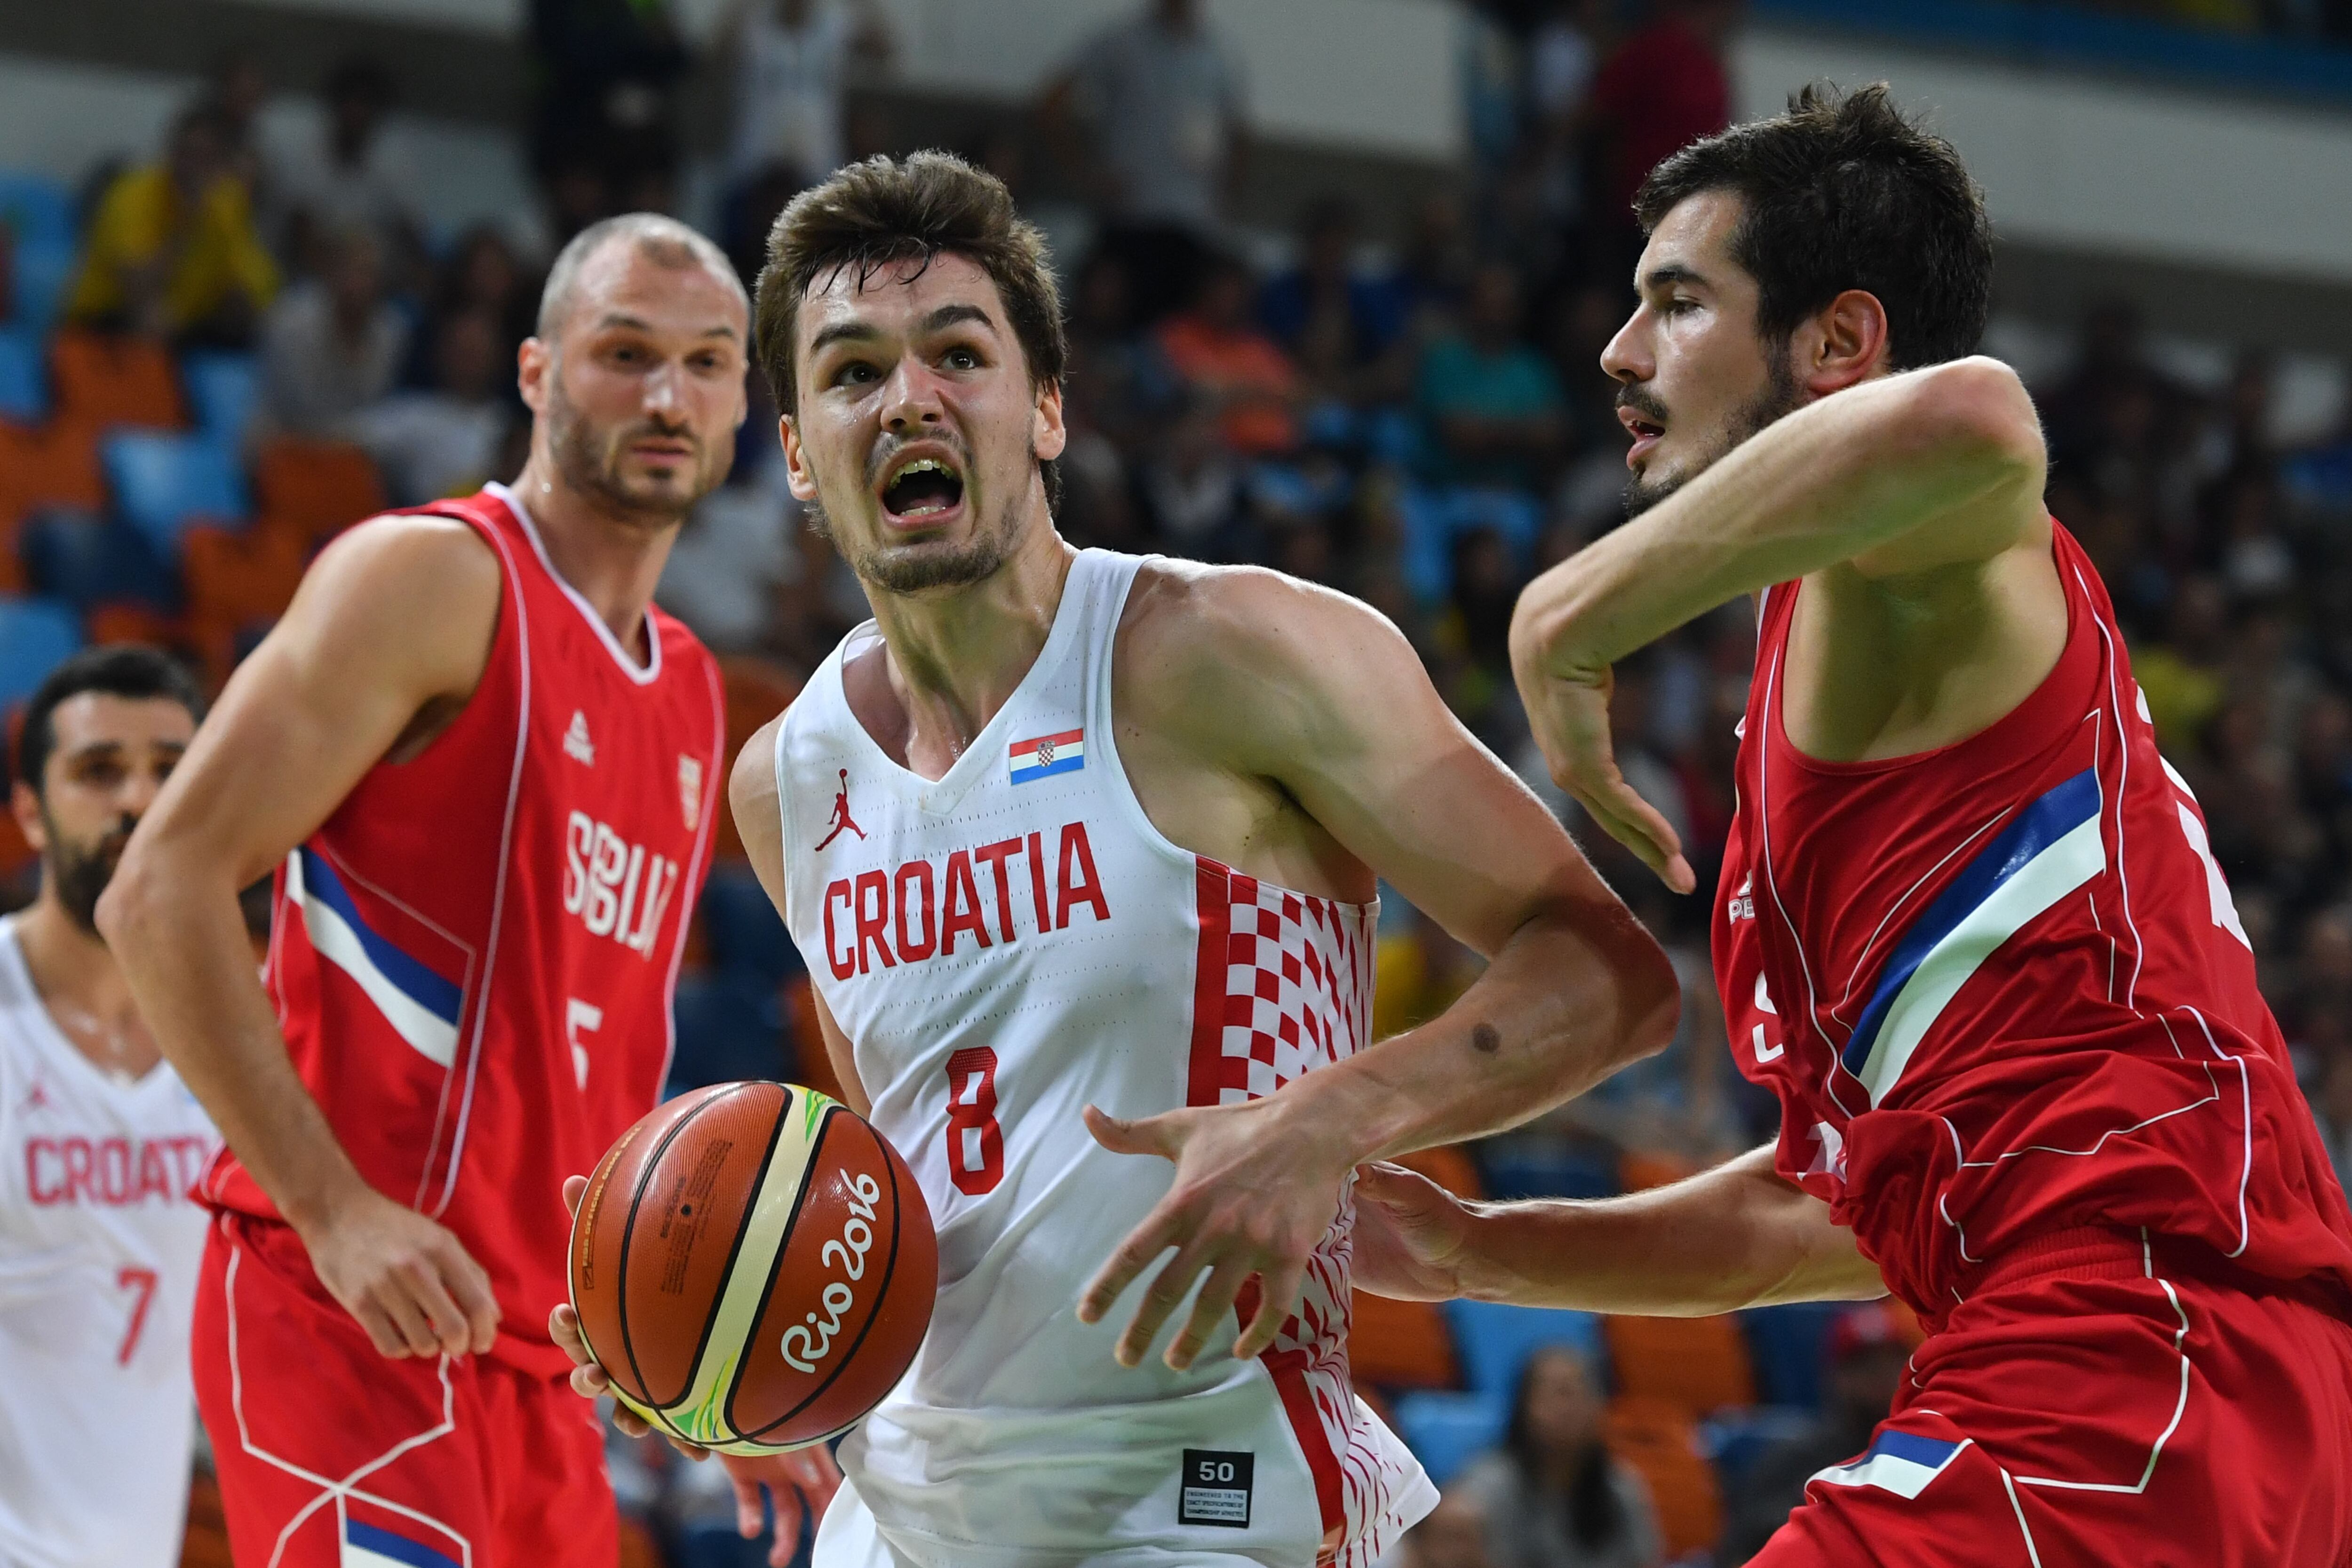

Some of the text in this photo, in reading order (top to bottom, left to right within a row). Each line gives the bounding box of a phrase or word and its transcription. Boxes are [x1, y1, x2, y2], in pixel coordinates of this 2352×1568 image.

[823, 820, 1111, 981] CROATIA
[1728, 899, 1755, 925] PE
[945, 1046, 1004, 1195] 8
[25, 1135, 207, 1207] CROAT
[116, 1267, 159, 1367] 7
[780, 1168, 880, 1374] Rio 2016
[1200, 1461, 1234, 1482] 50
